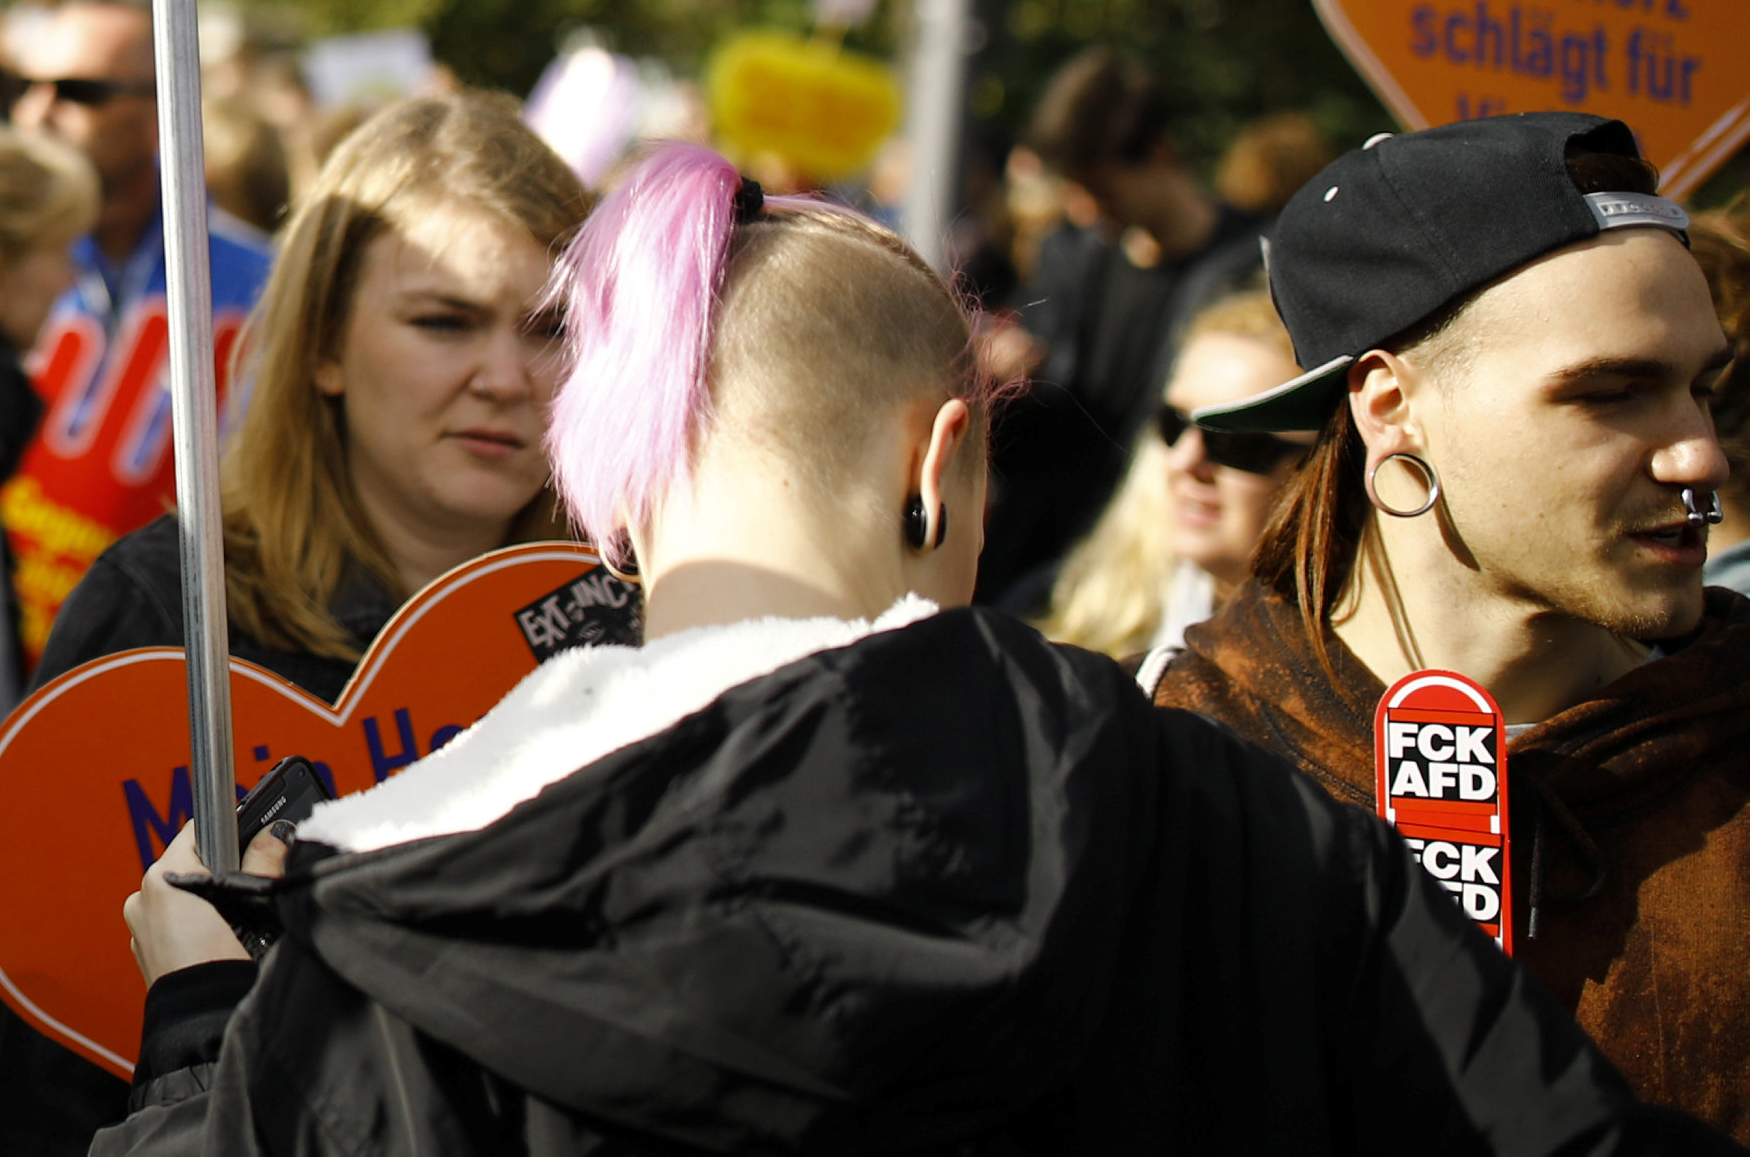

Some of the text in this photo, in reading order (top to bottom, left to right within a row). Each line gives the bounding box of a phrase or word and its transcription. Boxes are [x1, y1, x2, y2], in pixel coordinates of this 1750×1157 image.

[1410, 0, 1704, 106] schlägt für
[1388, 722, 1495, 764] FCK
[1391, 761, 1496, 801] AFD
[260, 795, 287, 825] SAMSUNG
